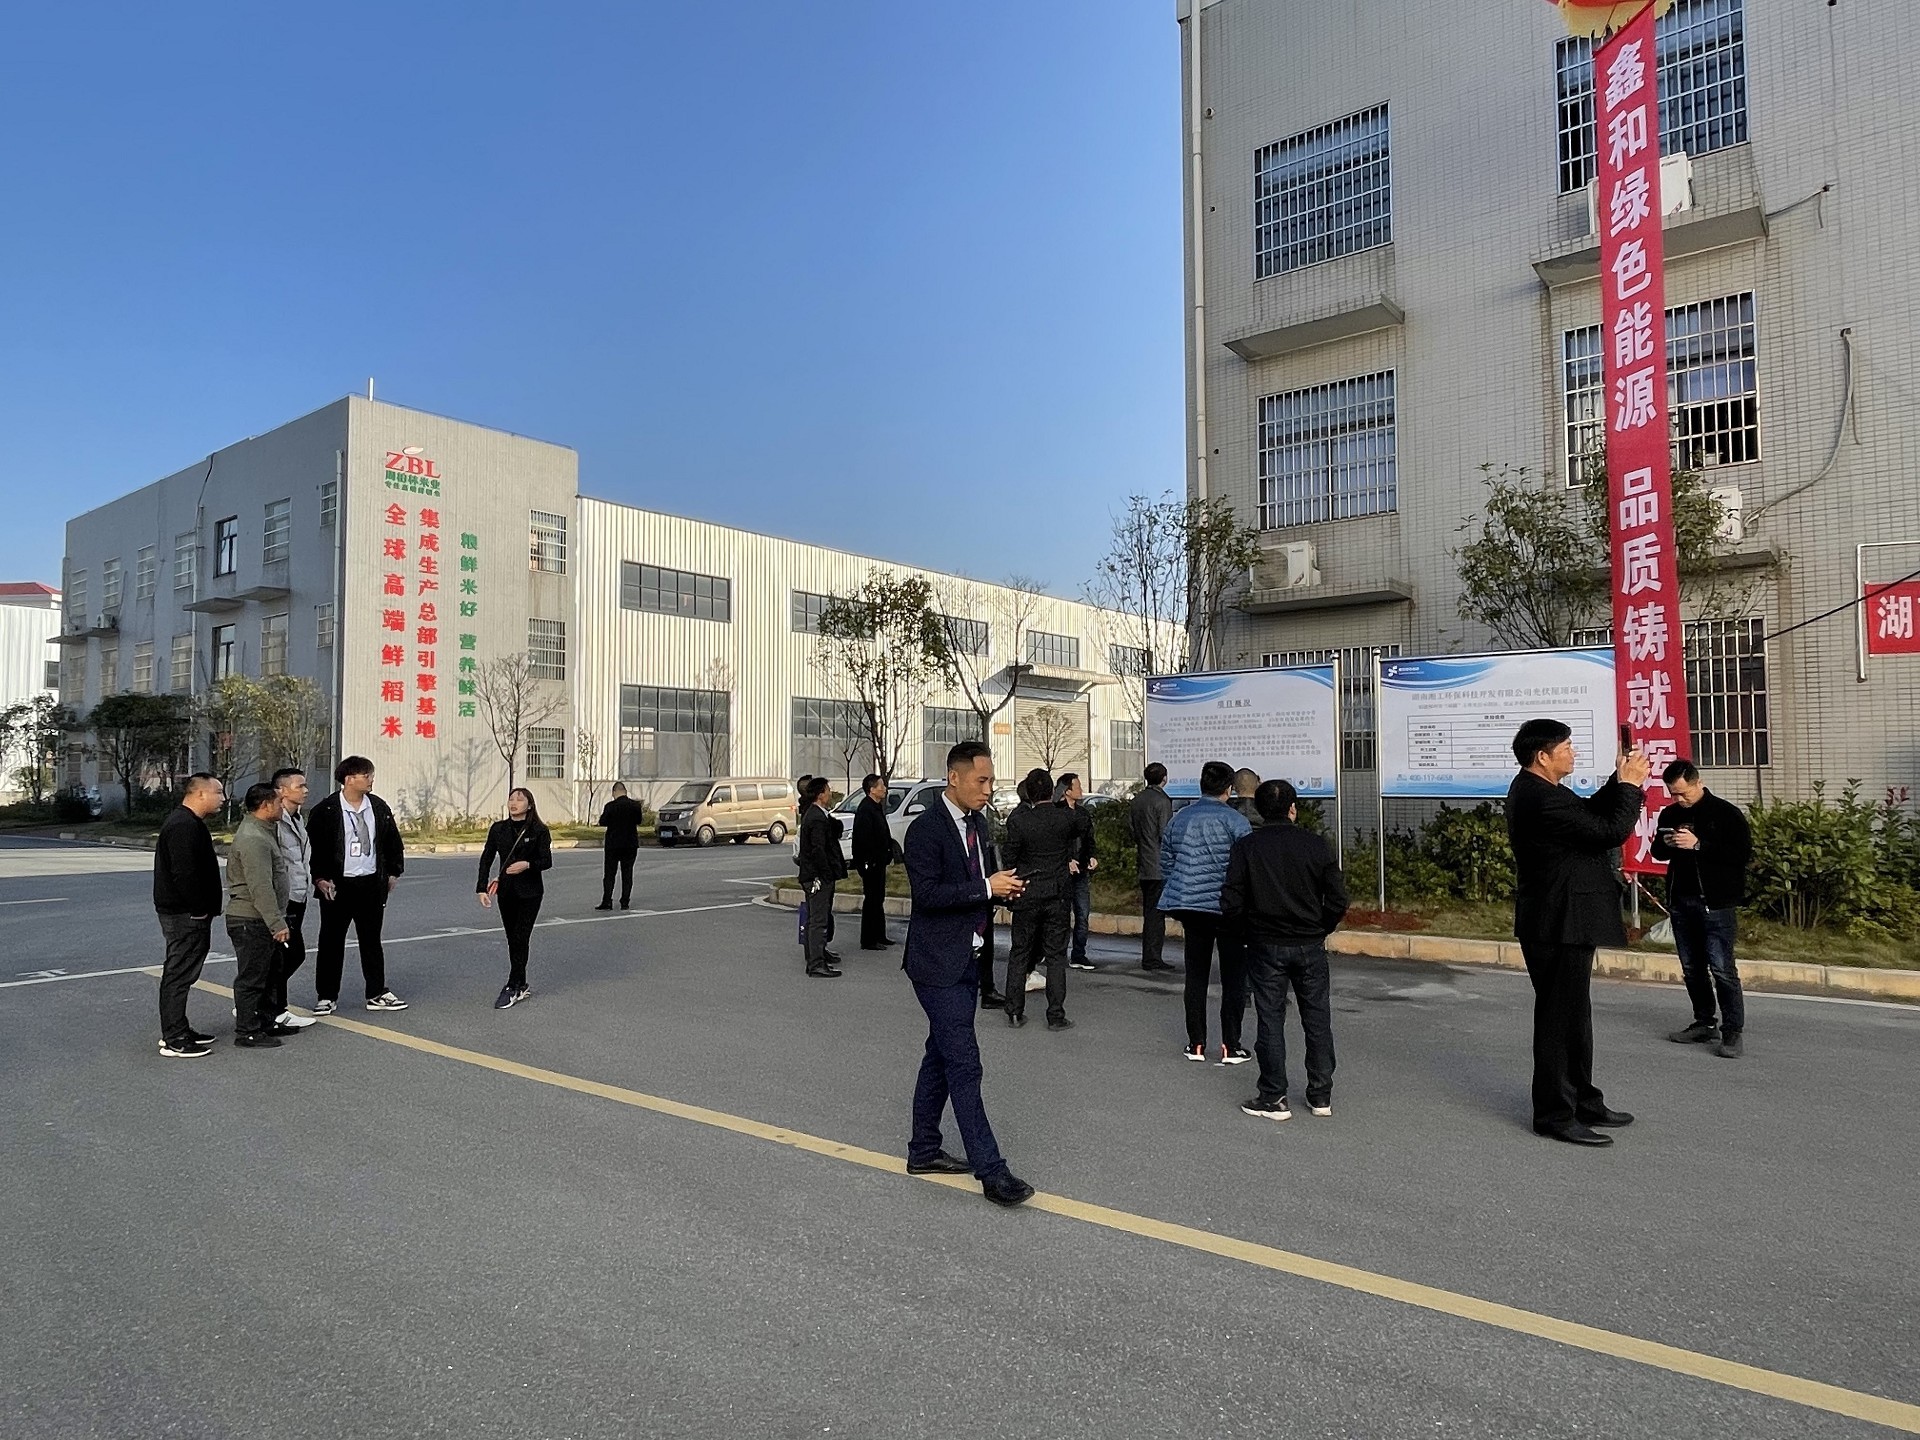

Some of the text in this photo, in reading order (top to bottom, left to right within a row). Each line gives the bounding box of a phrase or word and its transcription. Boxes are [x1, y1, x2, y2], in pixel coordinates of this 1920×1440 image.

[1604, 38, 1657, 432] 鑫和绿色能源
[385, 452, 441, 478] ZBL
[380, 503, 407, 738] 全球高端鲜稻米
[415, 508, 440, 739] 集成生产总部引擎基地
[458, 634, 478, 718] 营养鲜活
[1877, 595, 1920, 639] 湖
